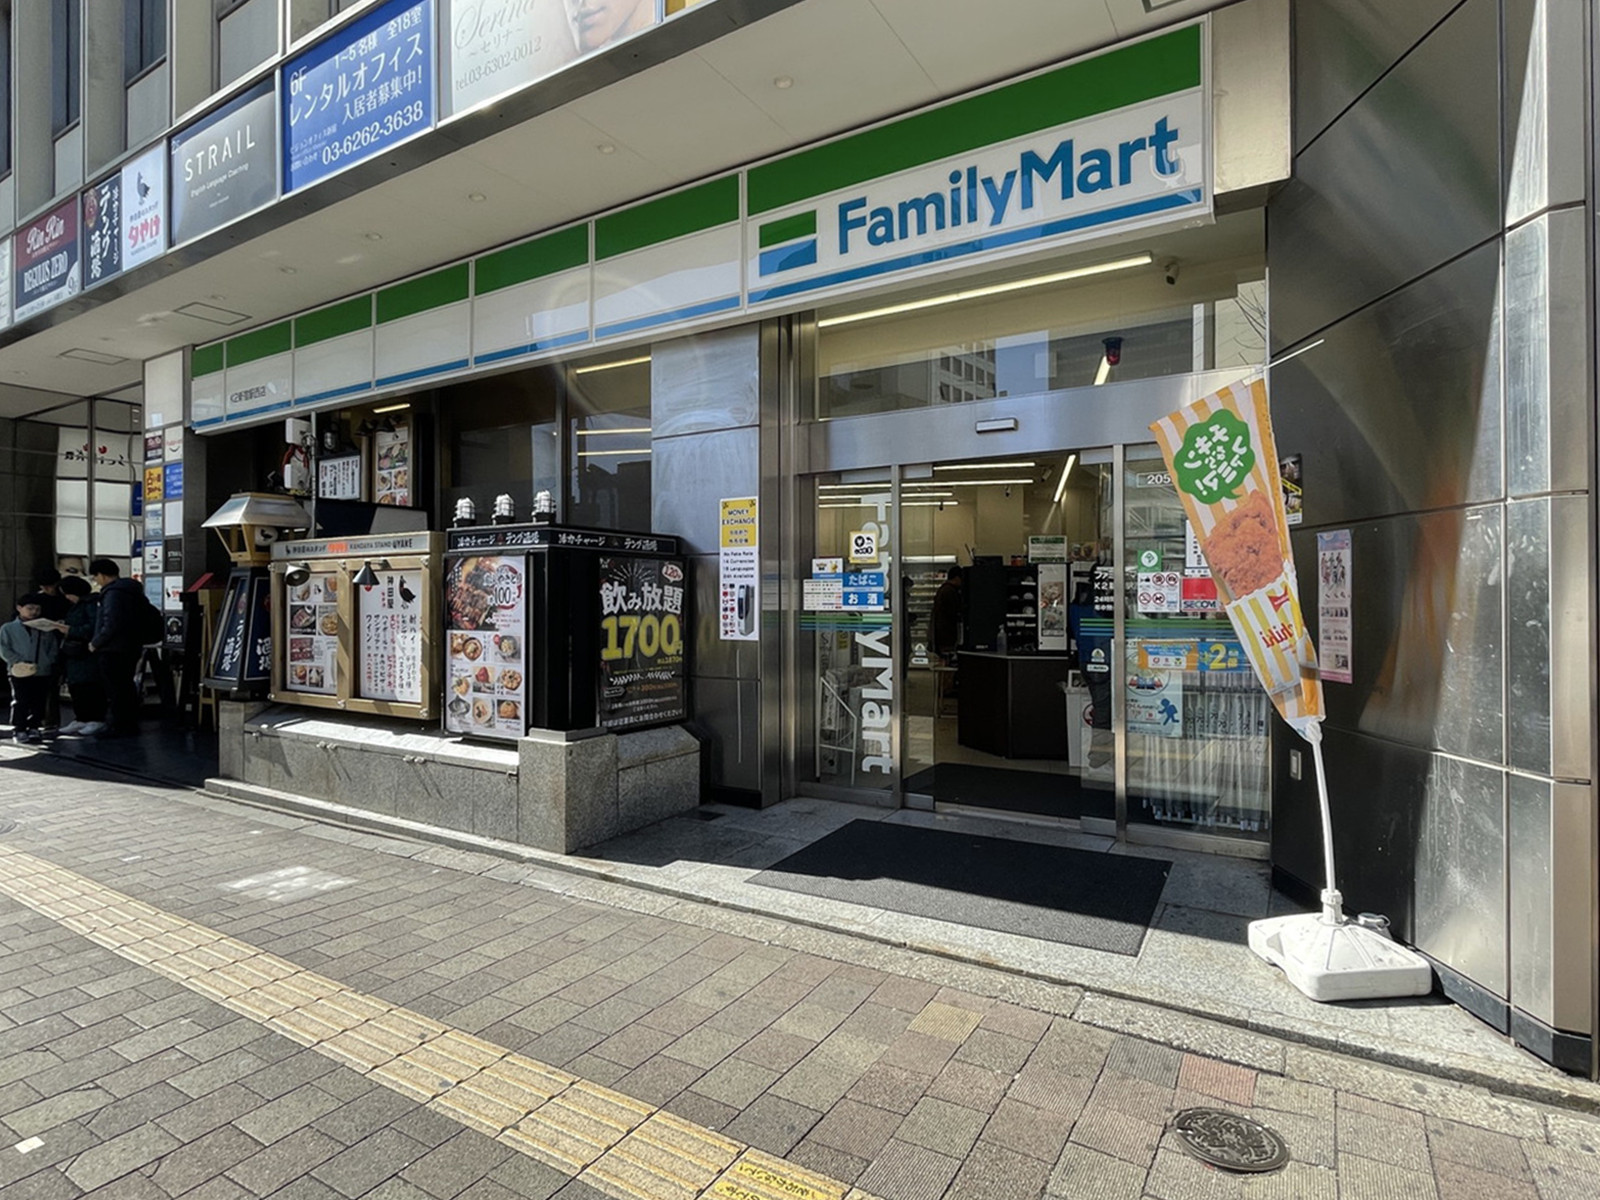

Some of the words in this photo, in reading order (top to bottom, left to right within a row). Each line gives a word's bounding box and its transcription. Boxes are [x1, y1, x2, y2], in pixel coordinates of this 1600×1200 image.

[290, 33, 424, 127] レンタルオフィス
[184, 124, 255, 182] STRAIL
[321, 100, 424, 166] 03-6262-3638
[839, 115, 1179, 254] FamilyMart
[1147, 474, 1171, 485] 205
[722, 518, 756, 526] EXCHANGE
[600, 581, 683, 615] 飲み放題
[848, 574, 878, 586] たばこ
